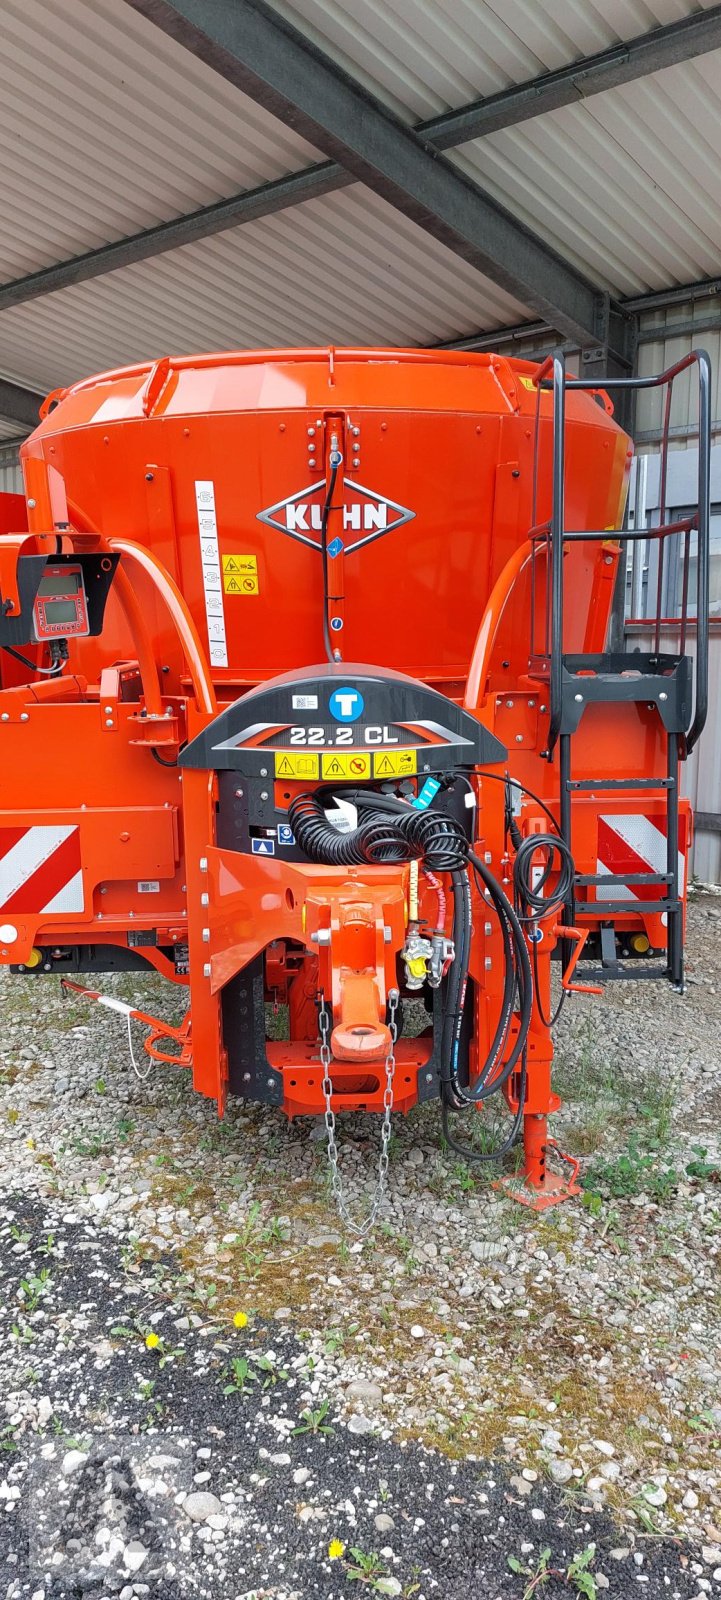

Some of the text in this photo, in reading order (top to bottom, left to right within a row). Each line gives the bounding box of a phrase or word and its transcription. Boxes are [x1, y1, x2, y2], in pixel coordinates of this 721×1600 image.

[199, 490, 211, 502] 6
[201, 518, 214, 530] 5
[204, 544, 215, 557] 4
[206, 571, 218, 583] 3
[208, 597, 220, 609] 2
[213, 623, 220, 634] 1
[212, 648, 225, 660] 0
[335, 694, 358, 716] T
[290, 726, 399, 745] 22.2 CL
